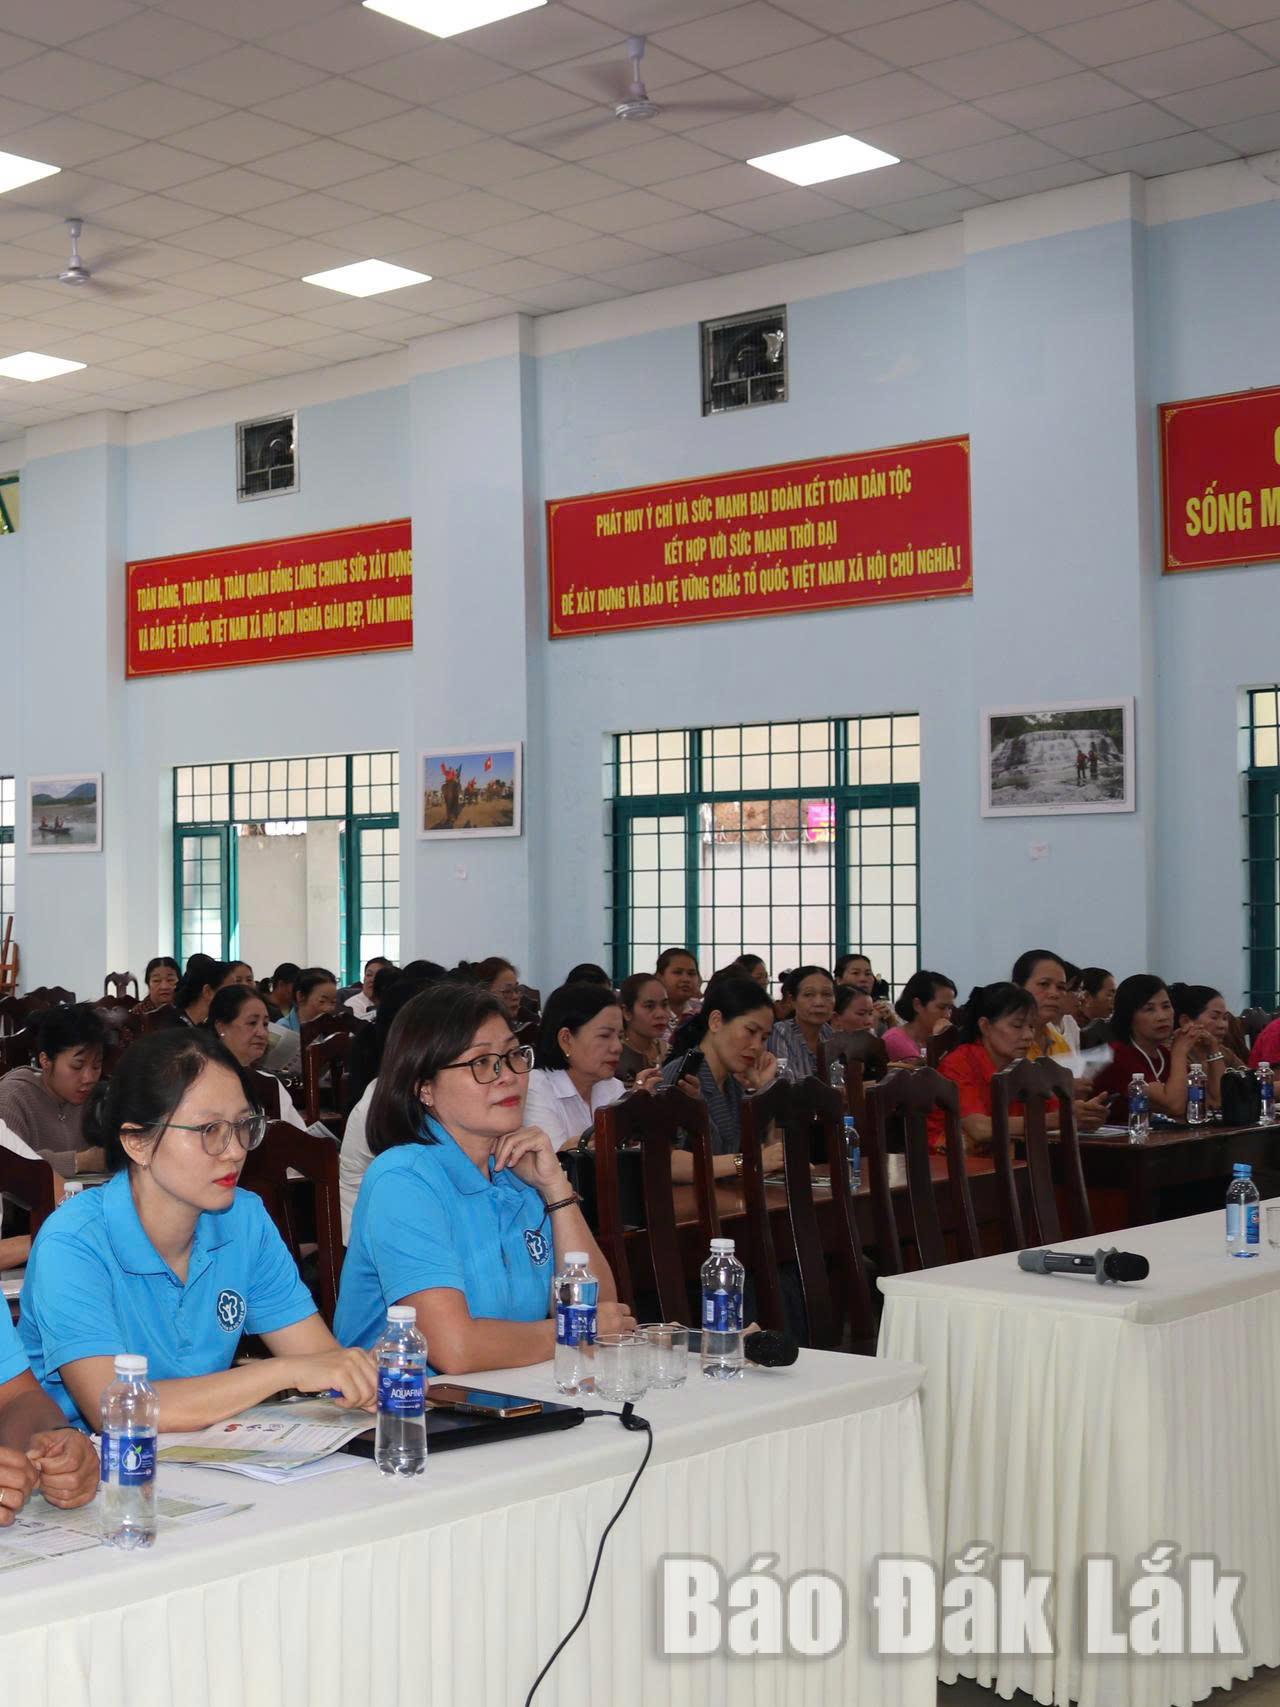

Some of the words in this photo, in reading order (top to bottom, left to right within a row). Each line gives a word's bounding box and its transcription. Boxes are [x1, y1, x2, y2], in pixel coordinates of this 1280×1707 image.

[596, 508, 623, 537] PHÁT
[624, 508, 644, 533] HUY
[646, 501, 653, 530] Ý
[655, 498, 673, 528] CHÍ
[675, 496, 690, 526] VÀ
[691, 494, 713, 523] SỨC
[715, 493, 747, 524] MẠNH
[750, 490, 768, 520] ĐẠI
[771, 481, 802, 513] ĐOÀN
[805, 474, 826, 508] KẾT
[828, 472, 859, 504] TOÀN
[861, 468, 886, 499] DÂN
[888, 464, 912, 500] TỘC
[1185, 480, 1253, 537] SỐNG
[664, 533, 683, 566] KẾT
[685, 535, 707, 567] HỢP
[709, 530, 727, 560] VỚI
[730, 527, 752, 557] SỨC
[754, 527, 787, 558] MẠNH
[789, 517, 816, 550] THỜI
[817, 519, 838, 550] ĐẠI
[561, 583, 575, 616] ĐỂ
[576, 586, 596, 614] XÂY
[597, 585, 626, 616] DỰNG
[627, 580, 642, 608] VÀ
[643, 575, 664, 605] BẢO
[665, 575, 679, 608] VỆ
[681, 573, 710, 602] VỮNG
[712, 564, 741, 598] CHẮC
[742, 561, 757, 594] TỔ
[759, 558, 789, 595] QUỐC
[791, 559, 816, 593] VIỆT
[818, 559, 846, 586] NAM
[848, 552, 865, 583] XÃ
[867, 550, 888, 585] HỘI
[890, 542, 914, 576] CHỦ
